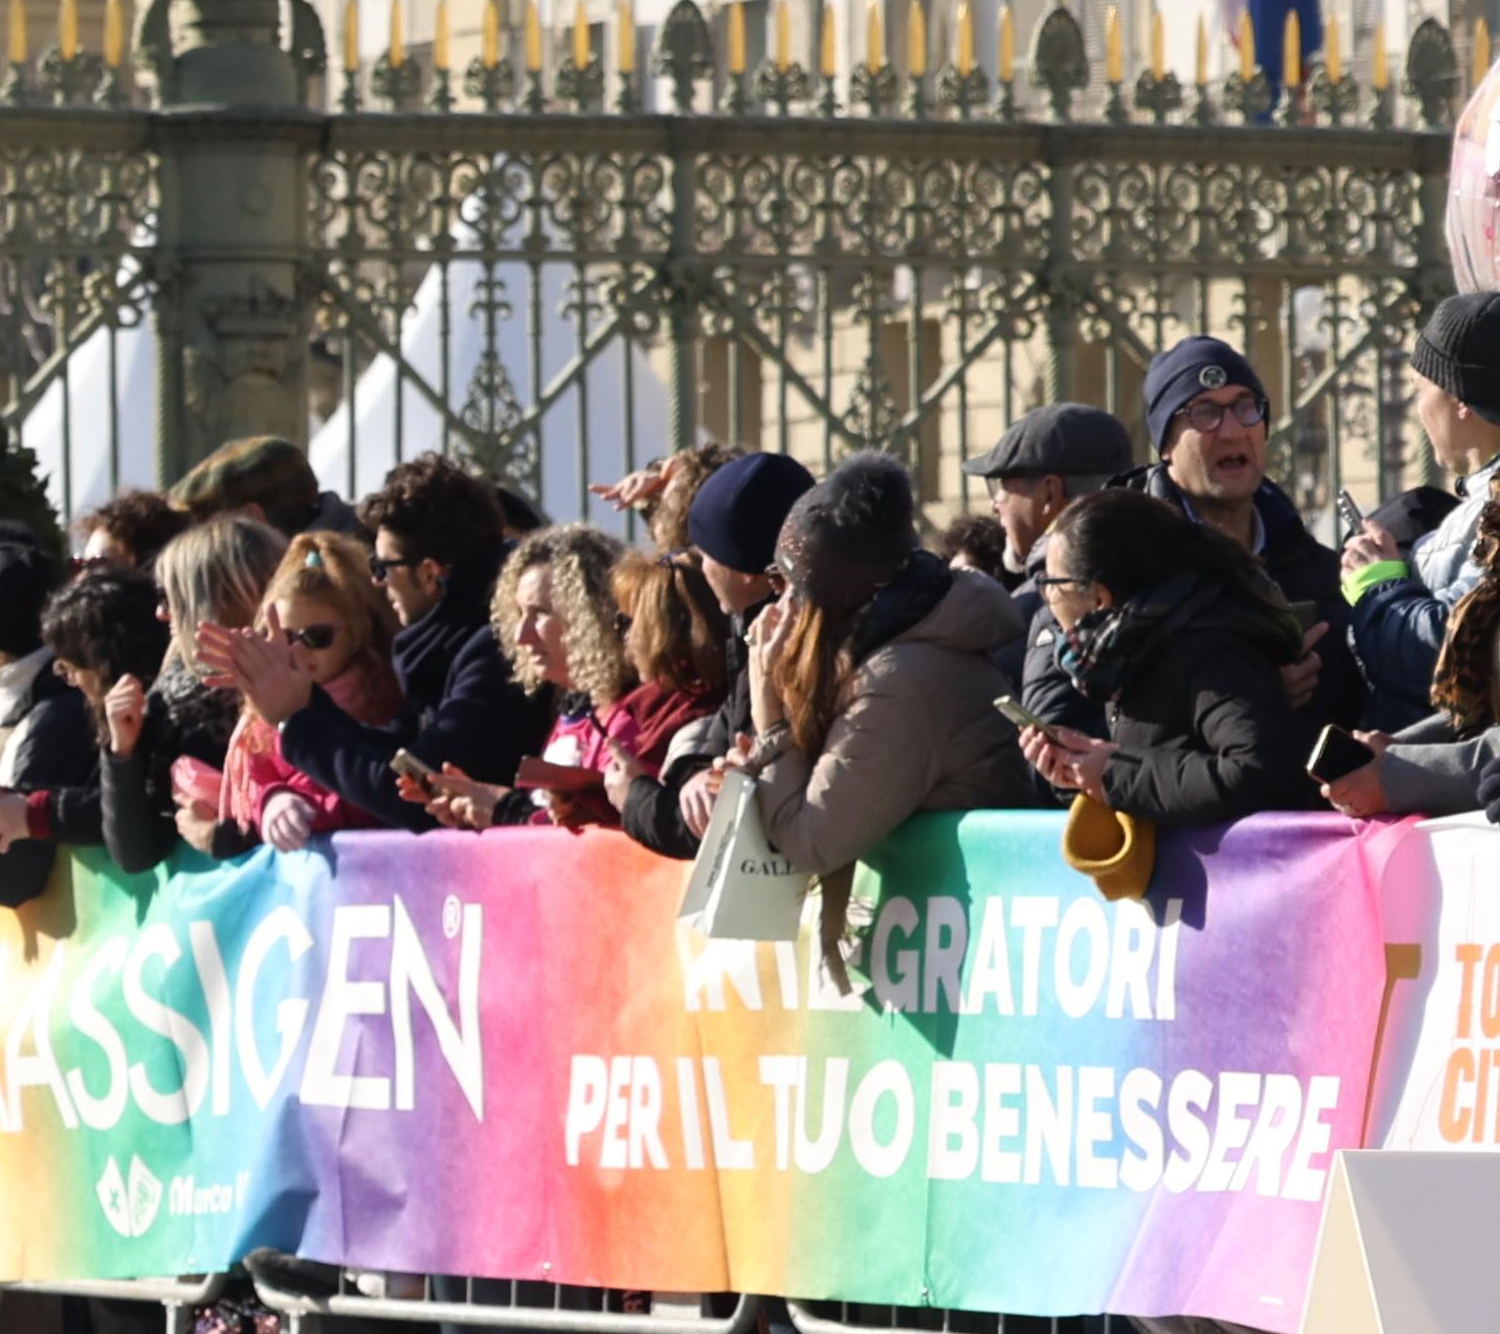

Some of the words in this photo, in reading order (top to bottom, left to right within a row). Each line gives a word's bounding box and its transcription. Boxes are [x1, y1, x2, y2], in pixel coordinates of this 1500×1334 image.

[1455, 942, 1500, 1042] TO
[564, 1054, 666, 1170] PER
[677, 1055, 755, 1171] IL
[759, 1056, 916, 1178] TUO
[930, 1058, 1342, 1204] BENESSERE
